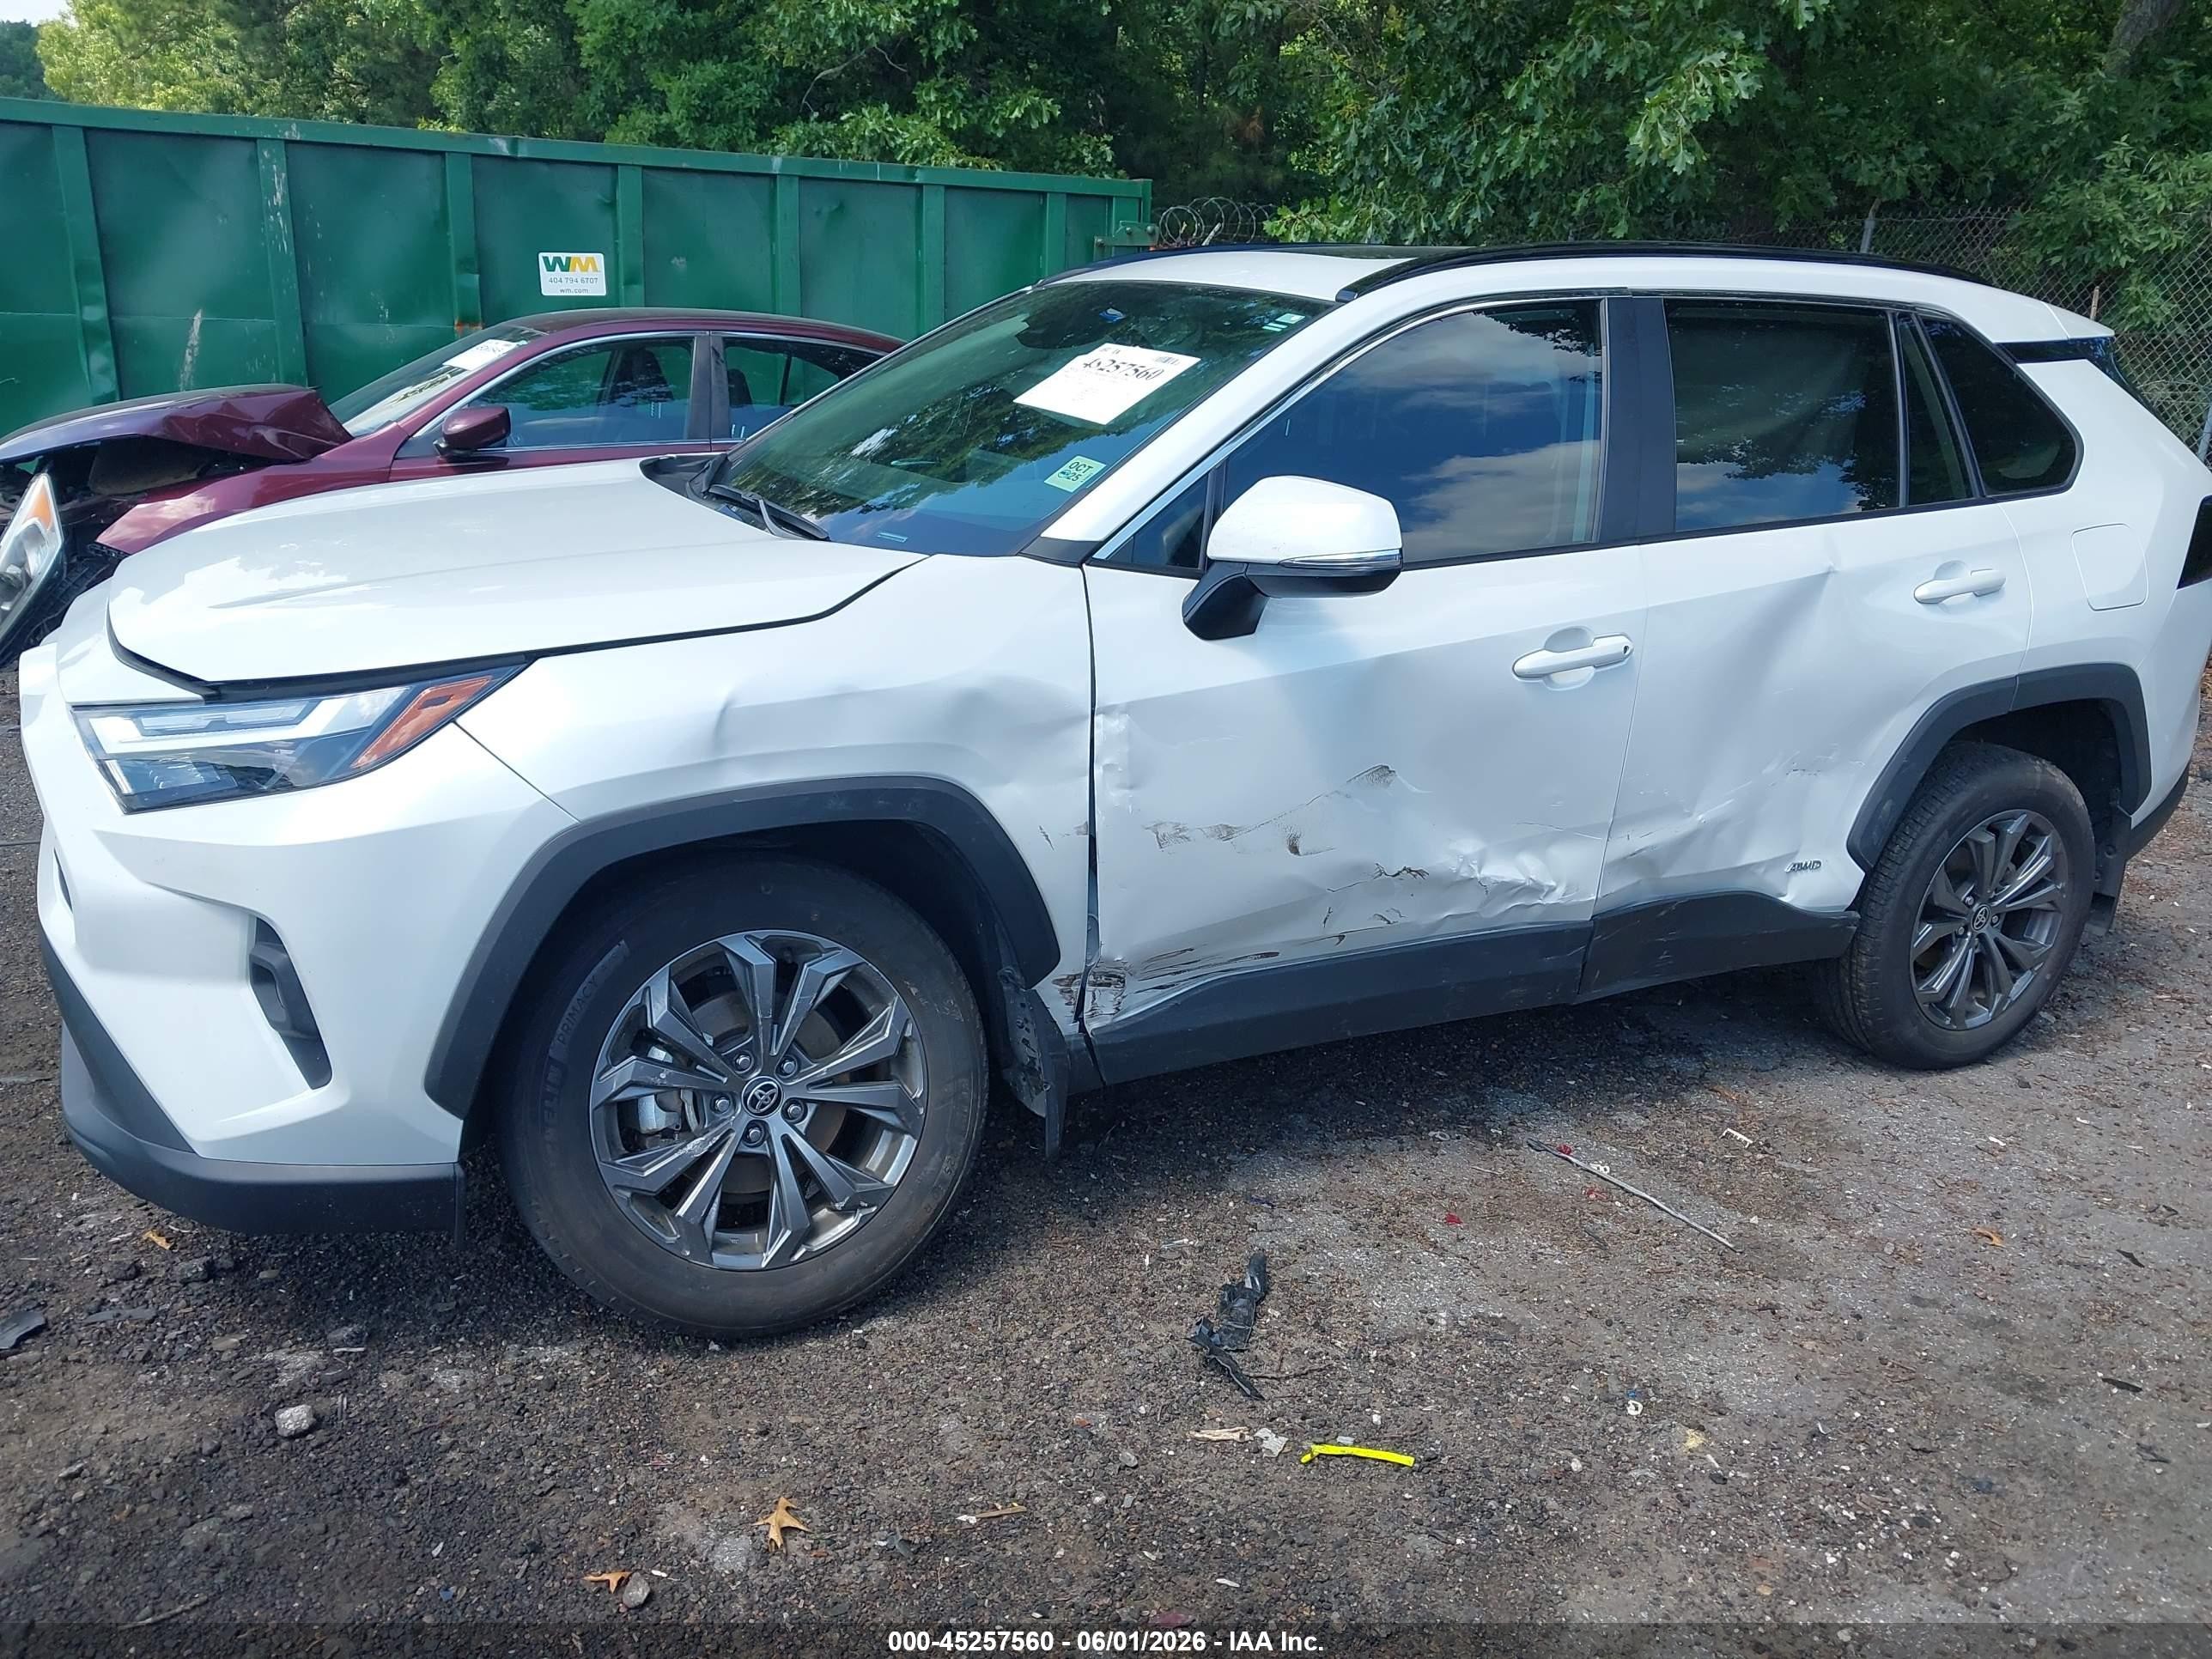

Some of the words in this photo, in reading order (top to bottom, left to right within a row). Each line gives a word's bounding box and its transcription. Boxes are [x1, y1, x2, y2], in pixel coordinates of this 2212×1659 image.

[542, 256, 599, 272] WM
[1068, 461, 1094, 474] OCT
[1784, 860, 1822, 873] AWD
[557, 974, 599, 1046] PRIMACY
